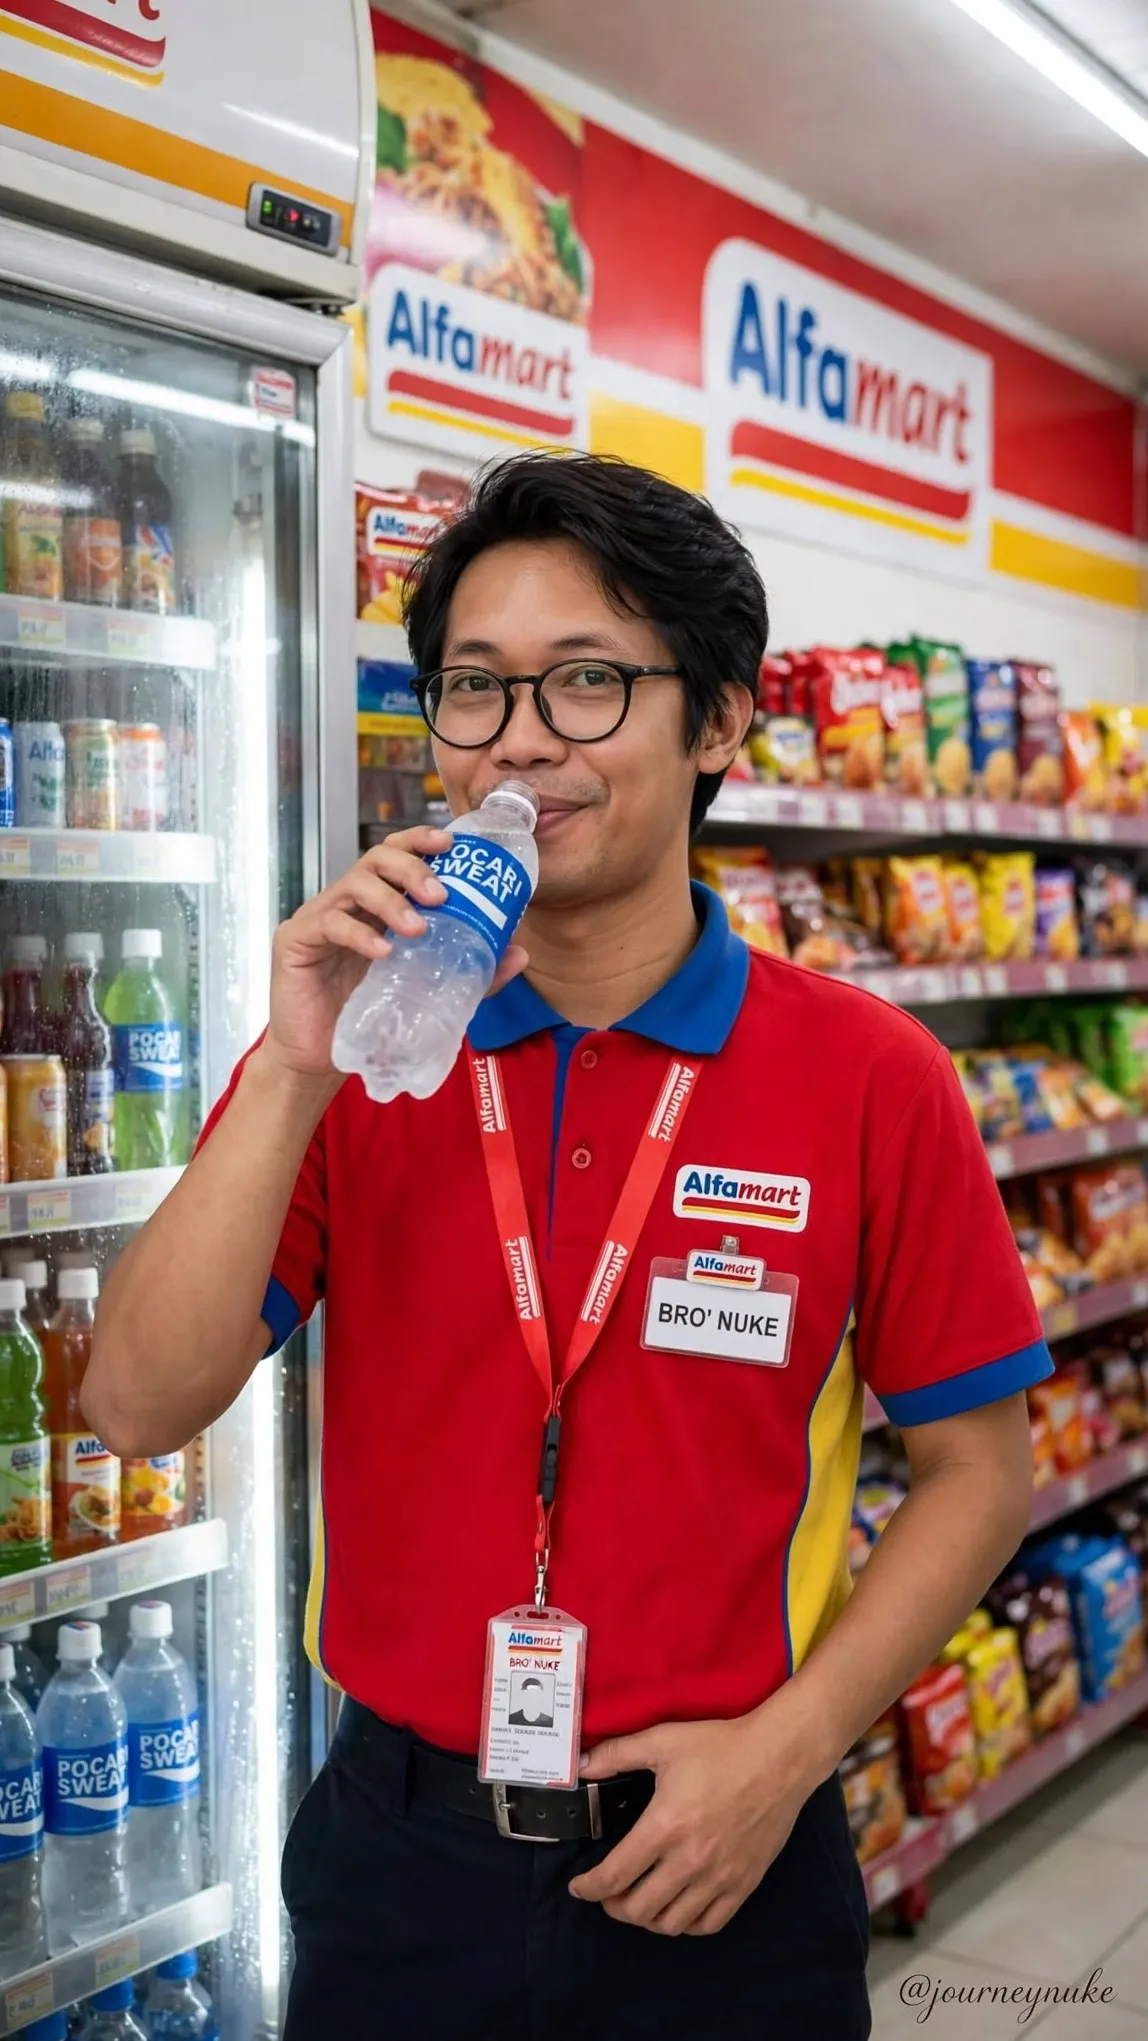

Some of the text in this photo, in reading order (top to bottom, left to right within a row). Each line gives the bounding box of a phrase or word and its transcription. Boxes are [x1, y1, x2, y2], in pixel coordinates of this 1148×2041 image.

[387, 289, 573, 401] Alfamart
[730, 281, 972, 465] Alfamart
[429, 857, 513, 903] SWEAT
[435, 843, 523, 897] OCARI
[472, 1057, 497, 1133] Alfamart
[657, 1065, 695, 1143] Alfamart
[683, 1171, 802, 1206] Alfamart
[505, 1238, 534, 1321] Alfamart
[588, 1243, 629, 1325] Alfamart
[693, 1255, 757, 1276] Alfamart
[658, 1302, 780, 1337] BRO' NUKE
[508, 1631, 564, 1647] Alfamart
[534, 1659, 561, 1671] NUKE
